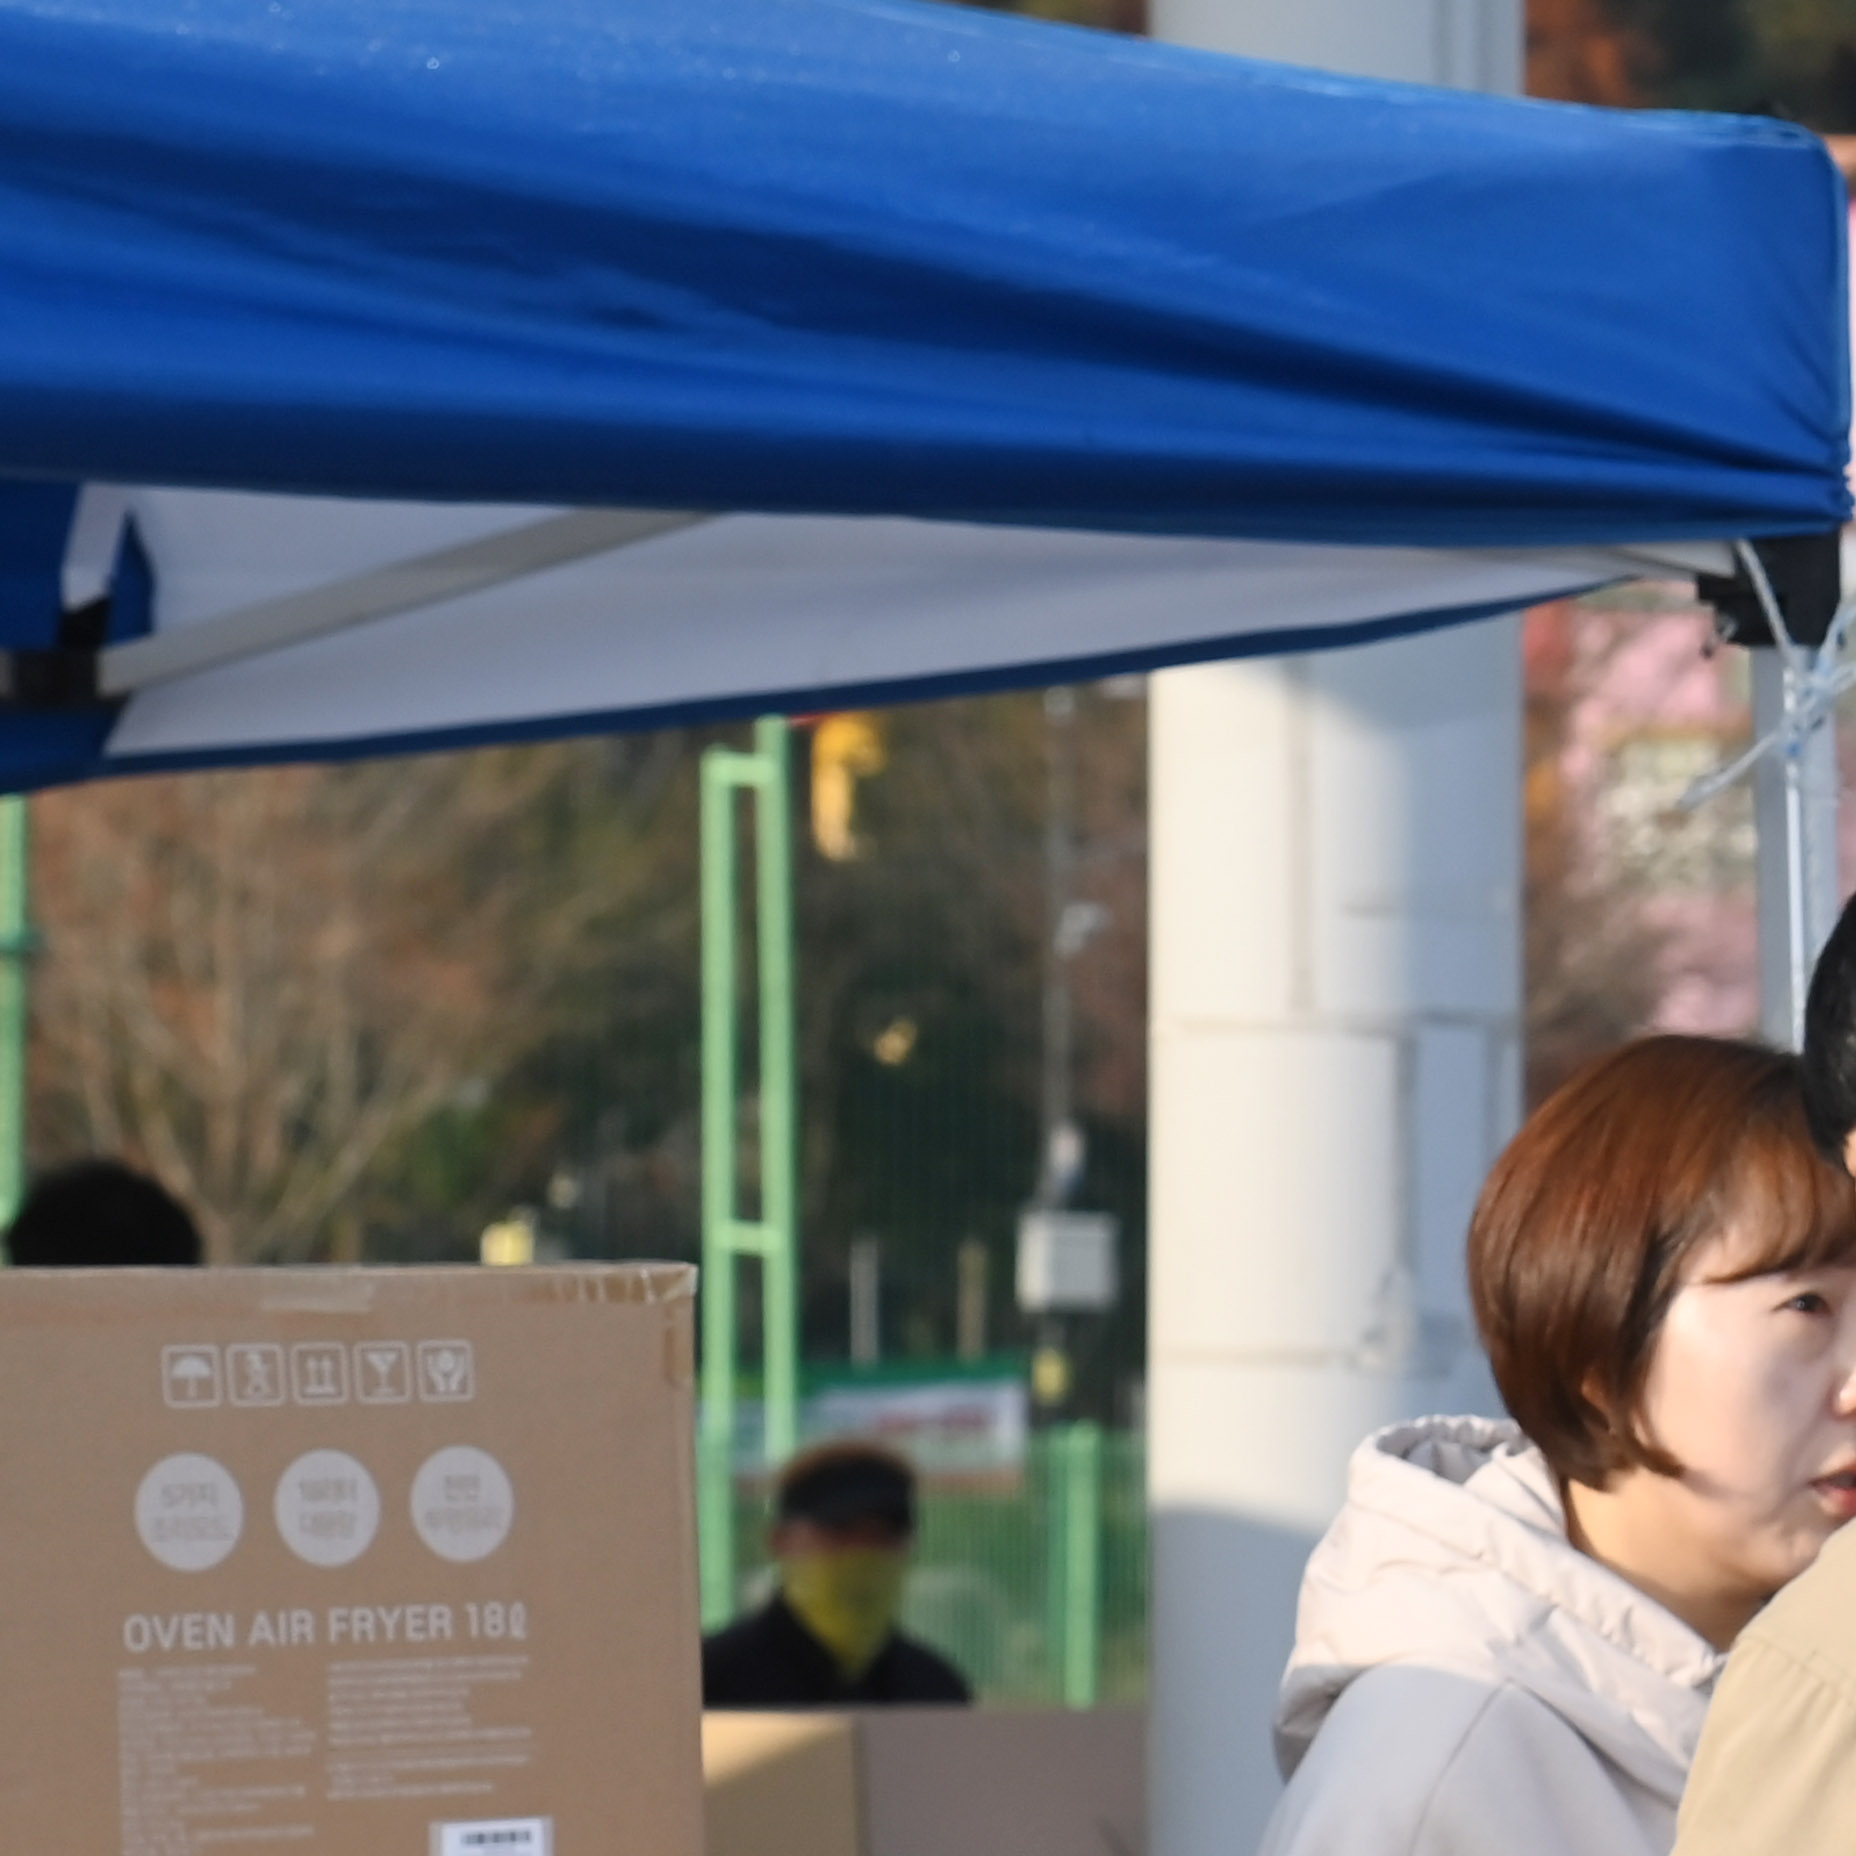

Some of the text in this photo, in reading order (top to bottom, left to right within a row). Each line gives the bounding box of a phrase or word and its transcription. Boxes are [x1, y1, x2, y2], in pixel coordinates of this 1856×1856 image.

[123, 1611, 236, 1653] OVEN
[249, 1608, 316, 1648] AIR
[328, 1603, 454, 1644] FRYER
